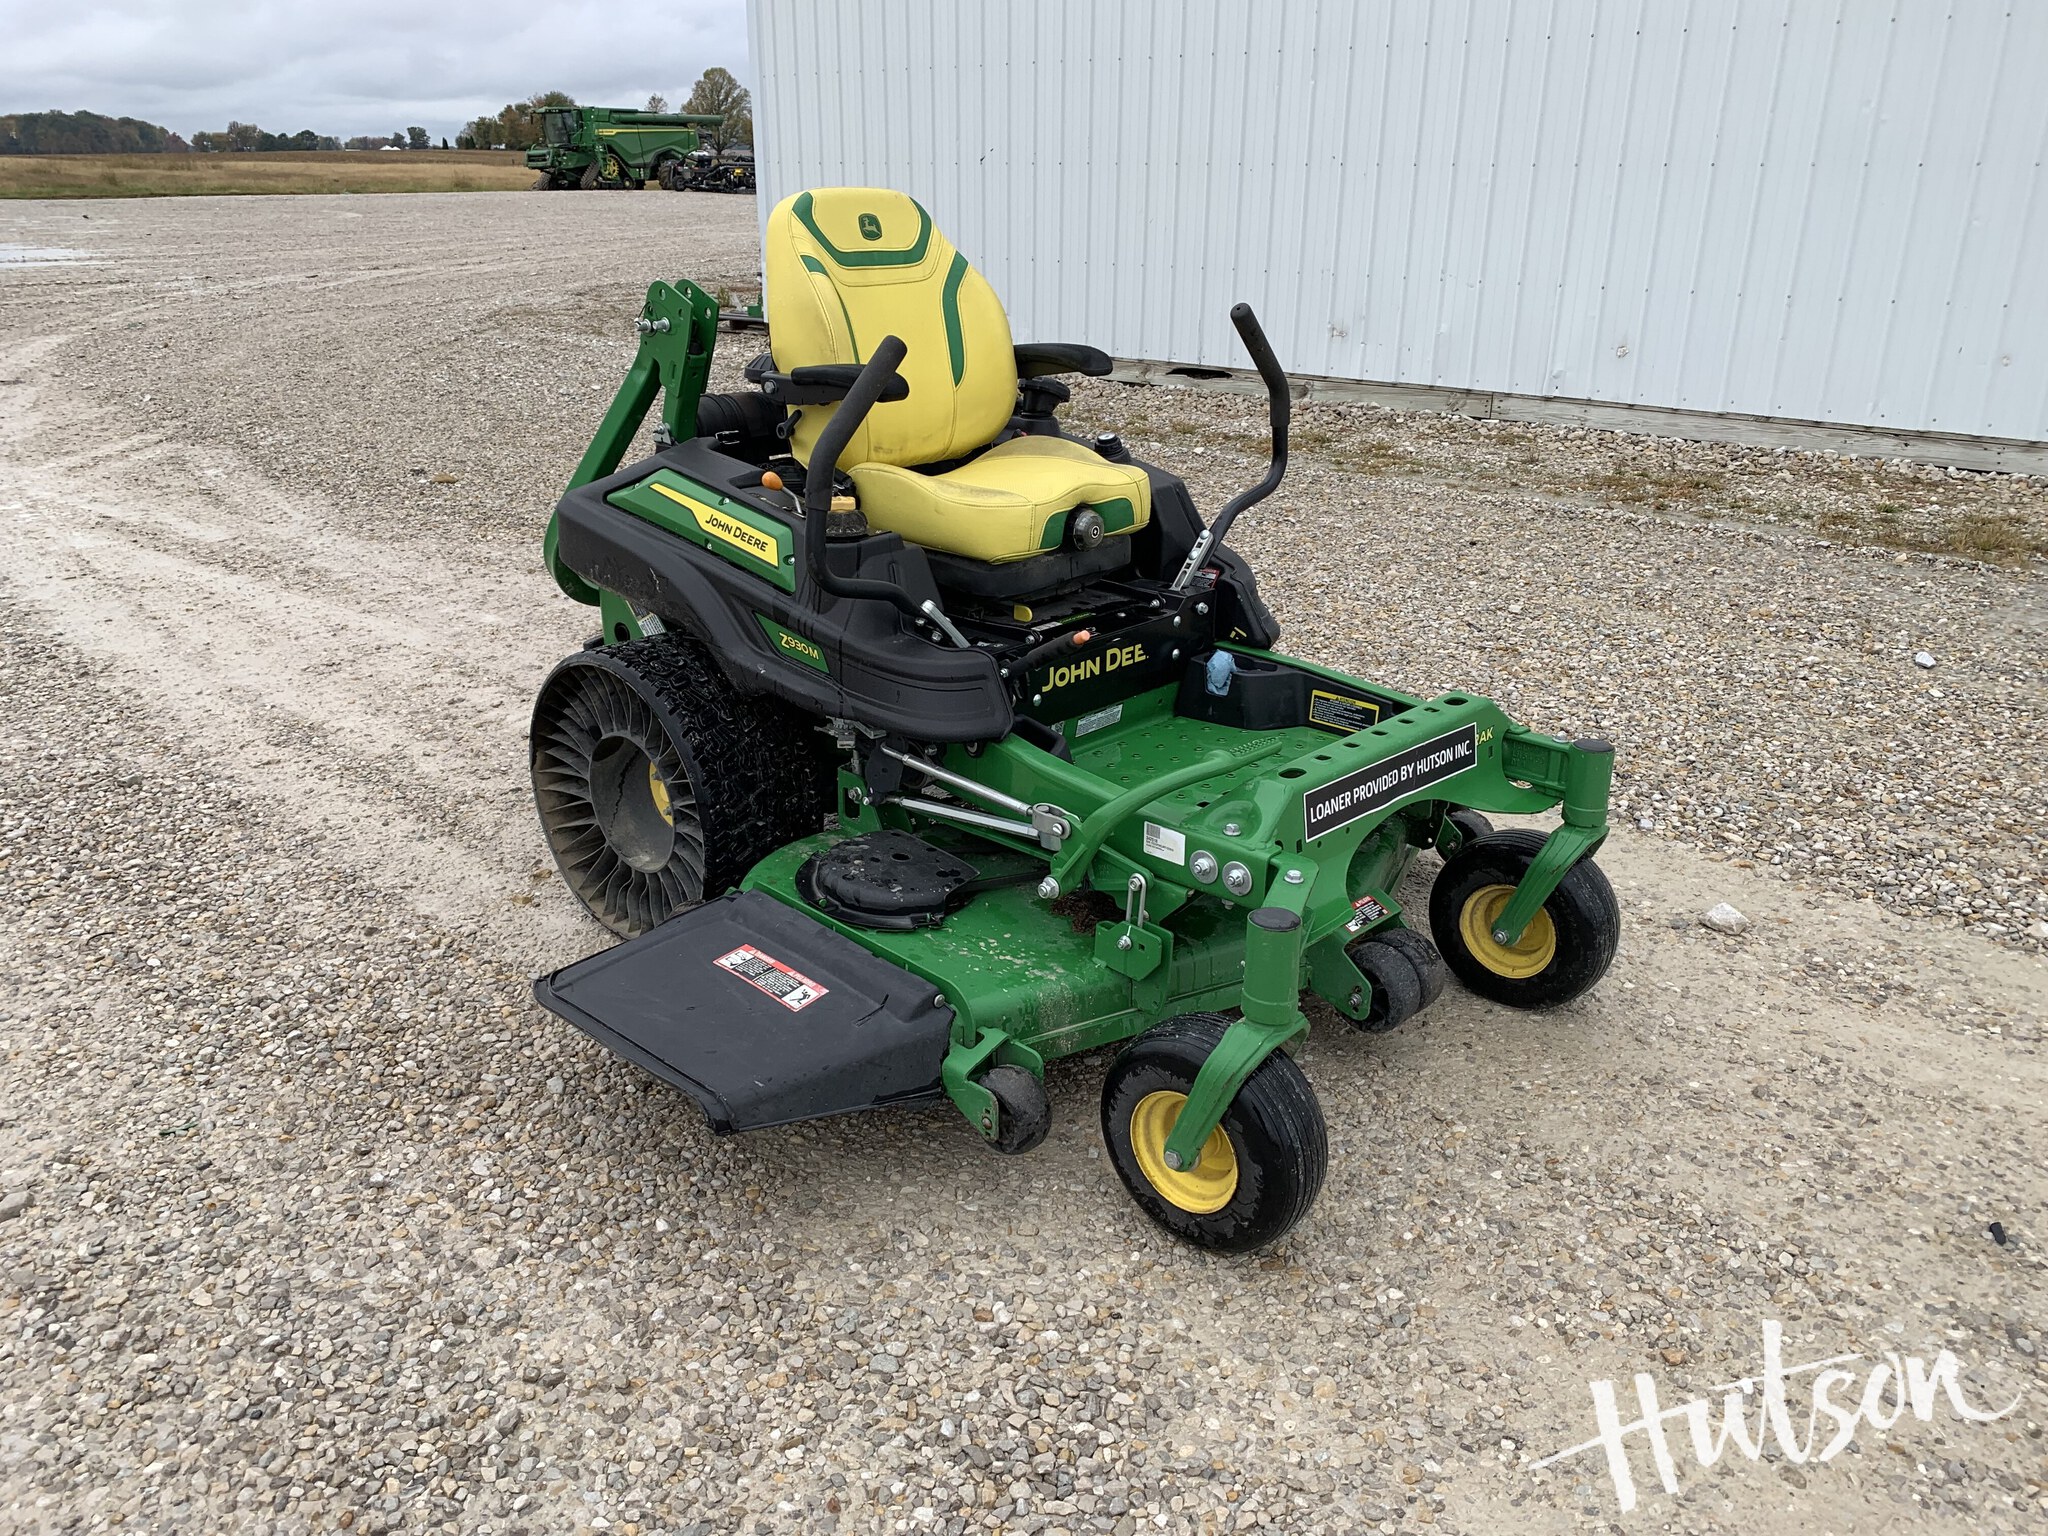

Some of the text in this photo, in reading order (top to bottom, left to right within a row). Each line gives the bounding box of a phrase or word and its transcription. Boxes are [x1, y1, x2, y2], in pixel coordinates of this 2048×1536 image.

[705, 514, 769, 552] JOHN DEERE
[779, 632, 819, 660] Z930M
[1041, 643, 1148, 693] JOHN DEE
[1310, 740, 1473, 824] LOANER PROVIDED BY HUTSON INC.
